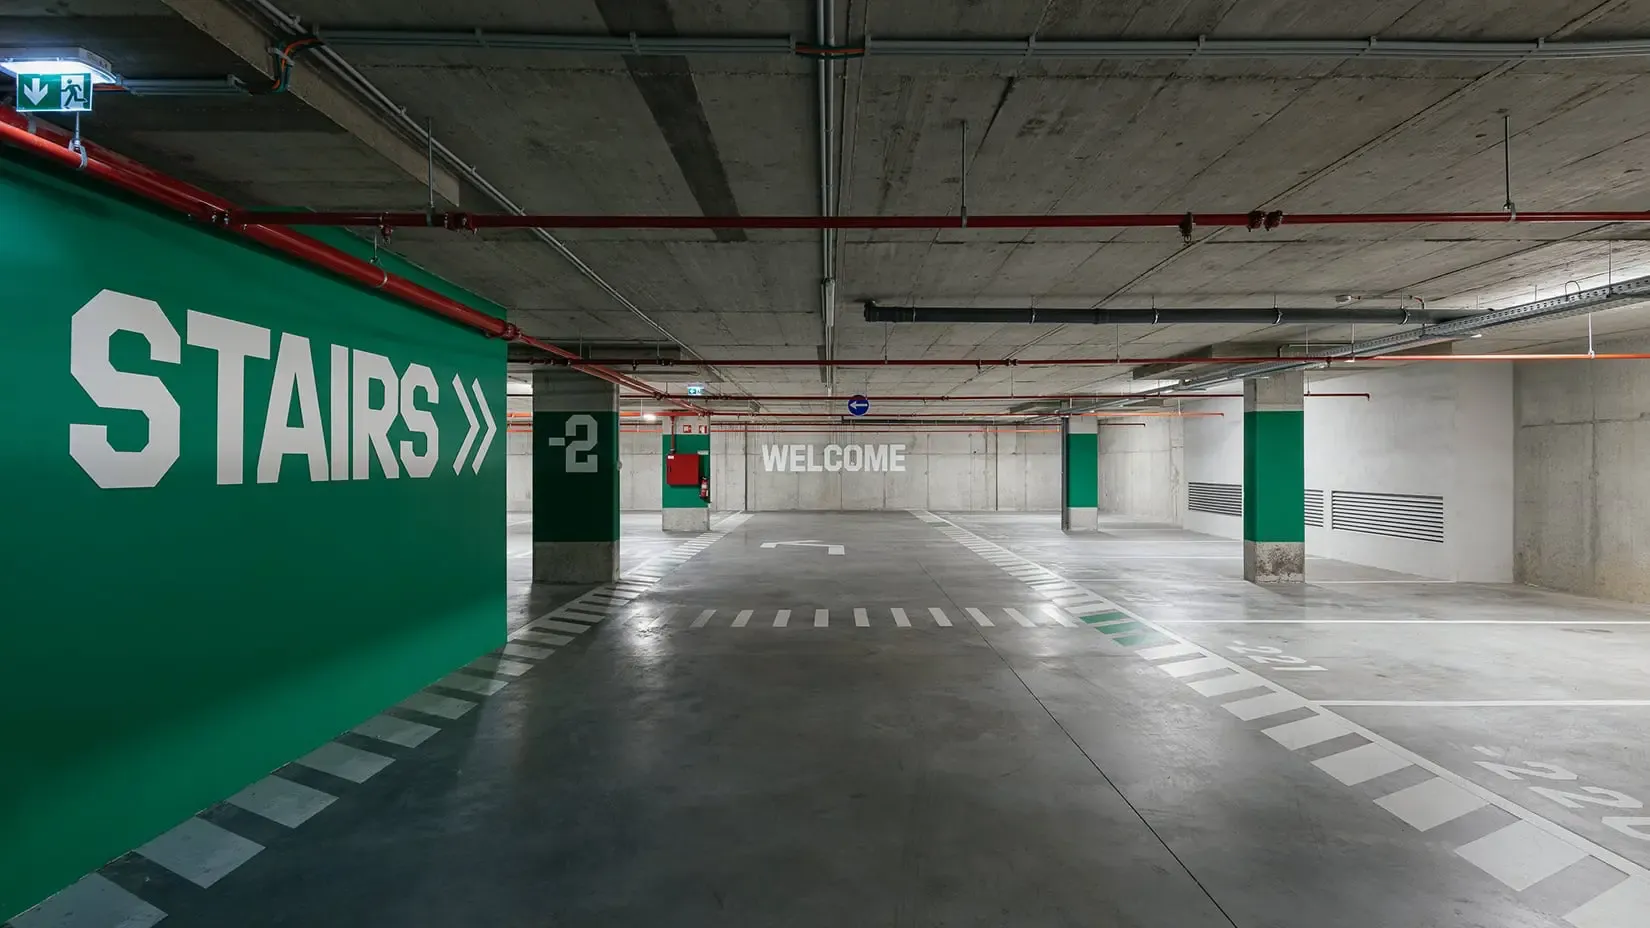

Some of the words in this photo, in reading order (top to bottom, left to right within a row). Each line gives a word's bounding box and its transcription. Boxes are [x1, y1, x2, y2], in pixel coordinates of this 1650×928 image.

[70, 289, 440, 489] STAIRS
[548, 415, 598, 473] -2
[762, 444, 905, 472] WELCOME
